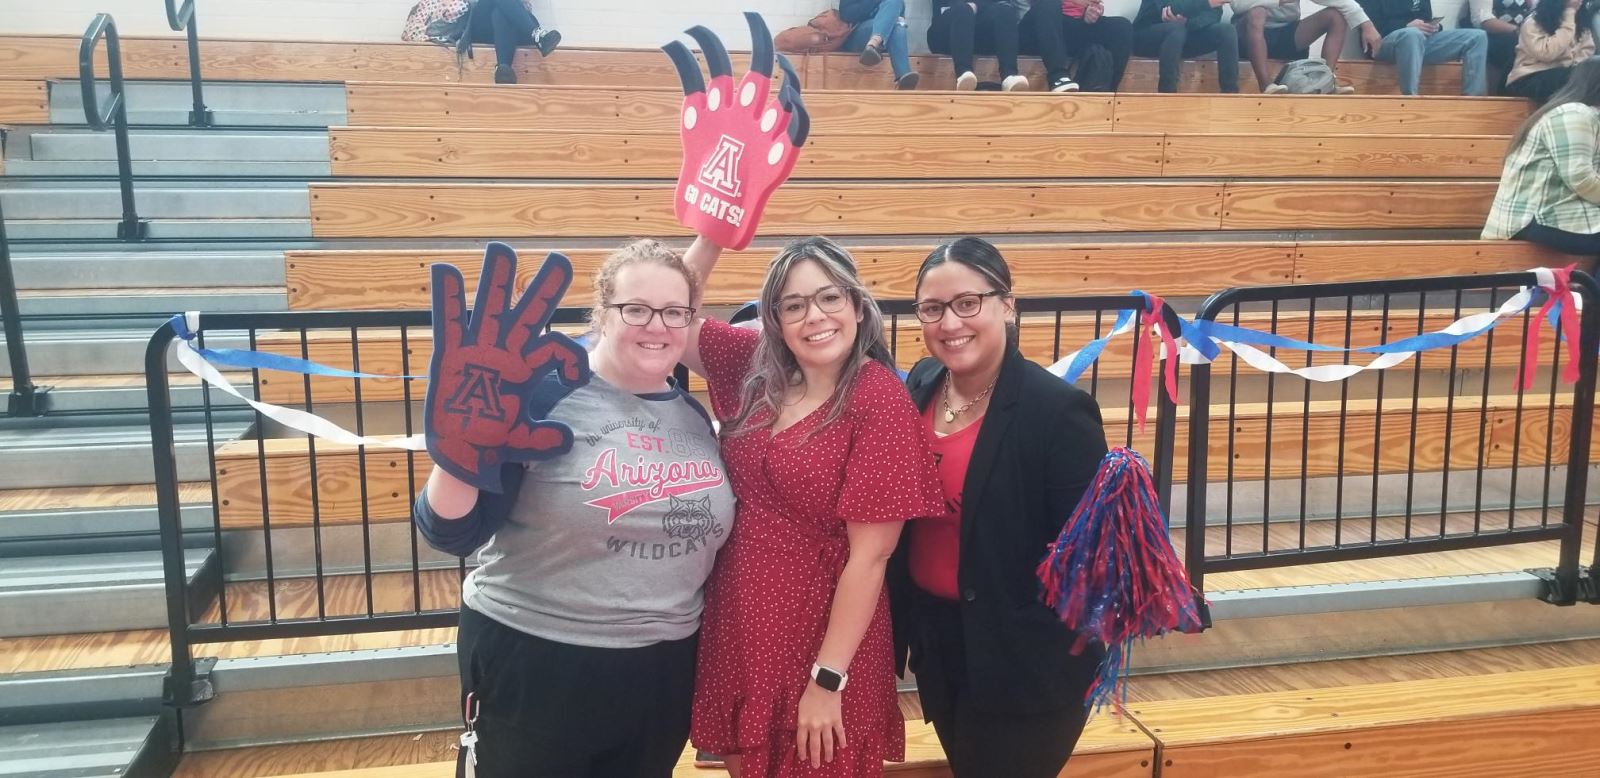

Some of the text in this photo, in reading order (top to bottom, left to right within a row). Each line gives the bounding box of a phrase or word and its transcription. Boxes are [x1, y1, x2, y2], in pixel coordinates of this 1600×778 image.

[698, 134, 745, 198] A
[700, 192, 745, 227] CATS!
[444, 363, 506, 432] A
[600, 417, 646, 434] university
[648, 418, 662, 432] of
[626, 427, 706, 458] EST. 85
[581, 448, 720, 498] Arizona
